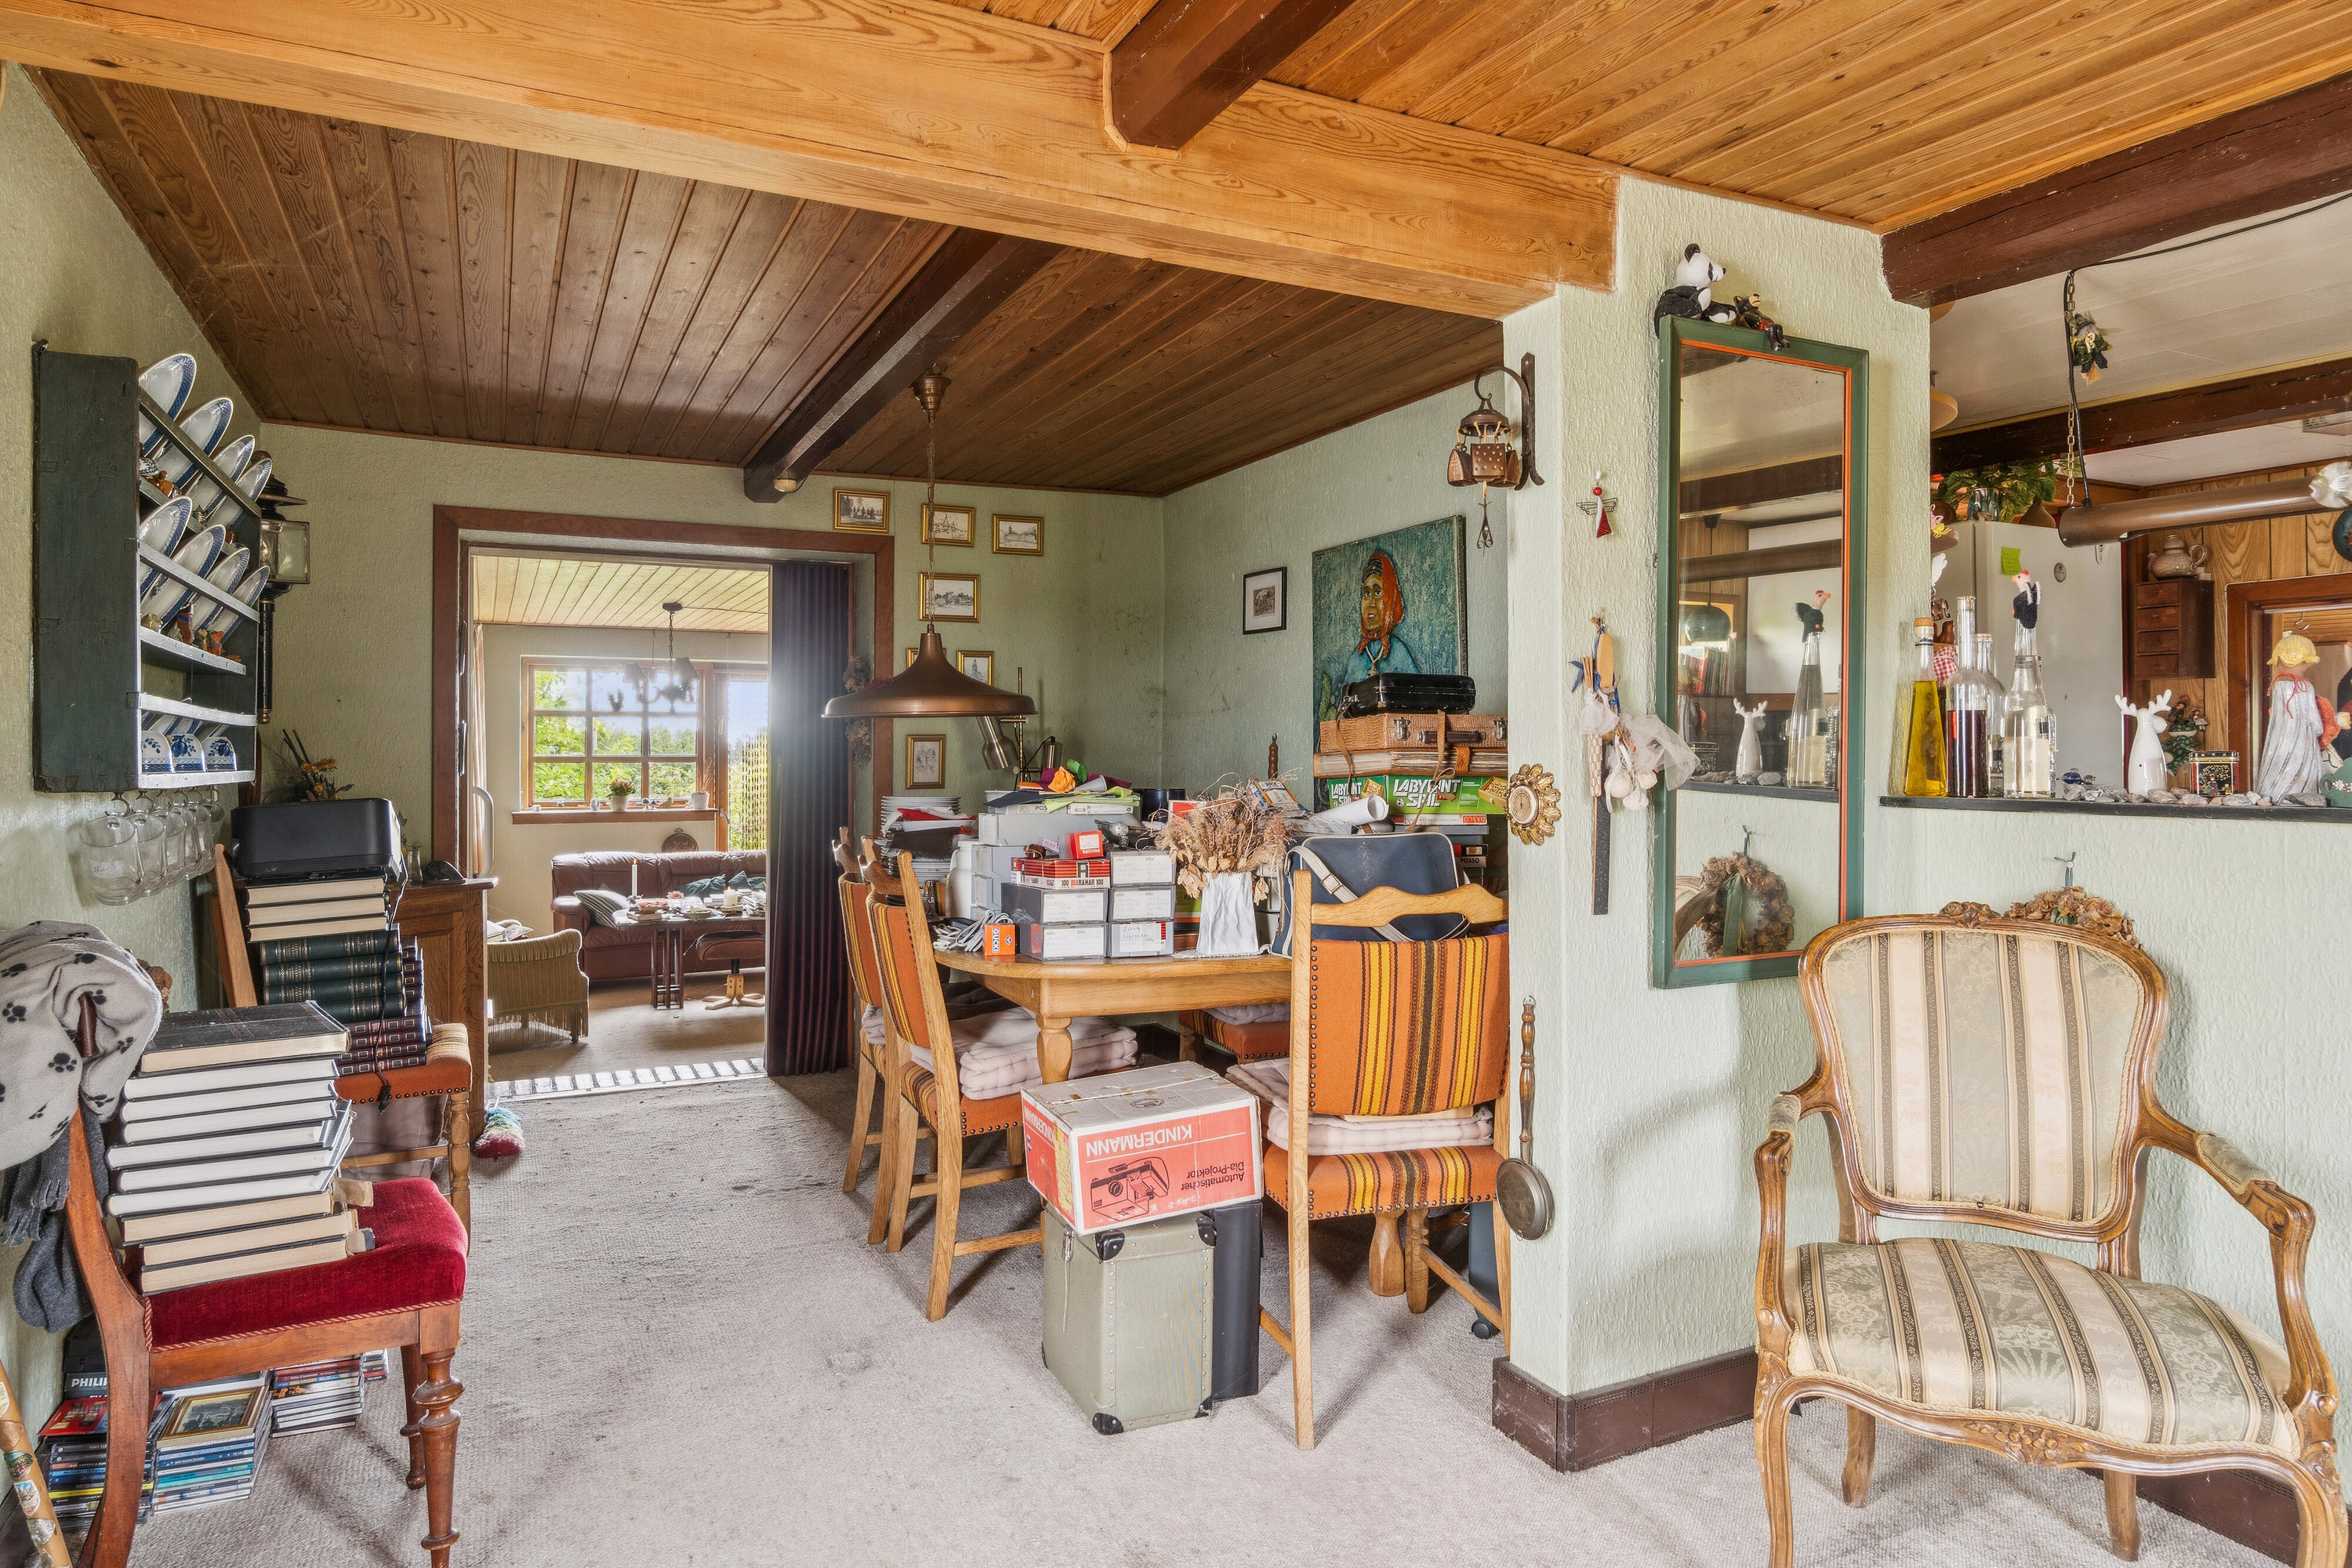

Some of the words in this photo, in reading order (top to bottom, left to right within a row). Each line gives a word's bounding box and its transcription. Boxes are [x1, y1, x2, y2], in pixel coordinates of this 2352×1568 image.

[1024, 1105, 1055, 1143] KINDERMANN
[1085, 1123, 1192, 1158] KINDERMANN
[1181, 1171, 1245, 1191] Automatischer
[1186, 1160, 1245, 1180] Dia-Projektor
